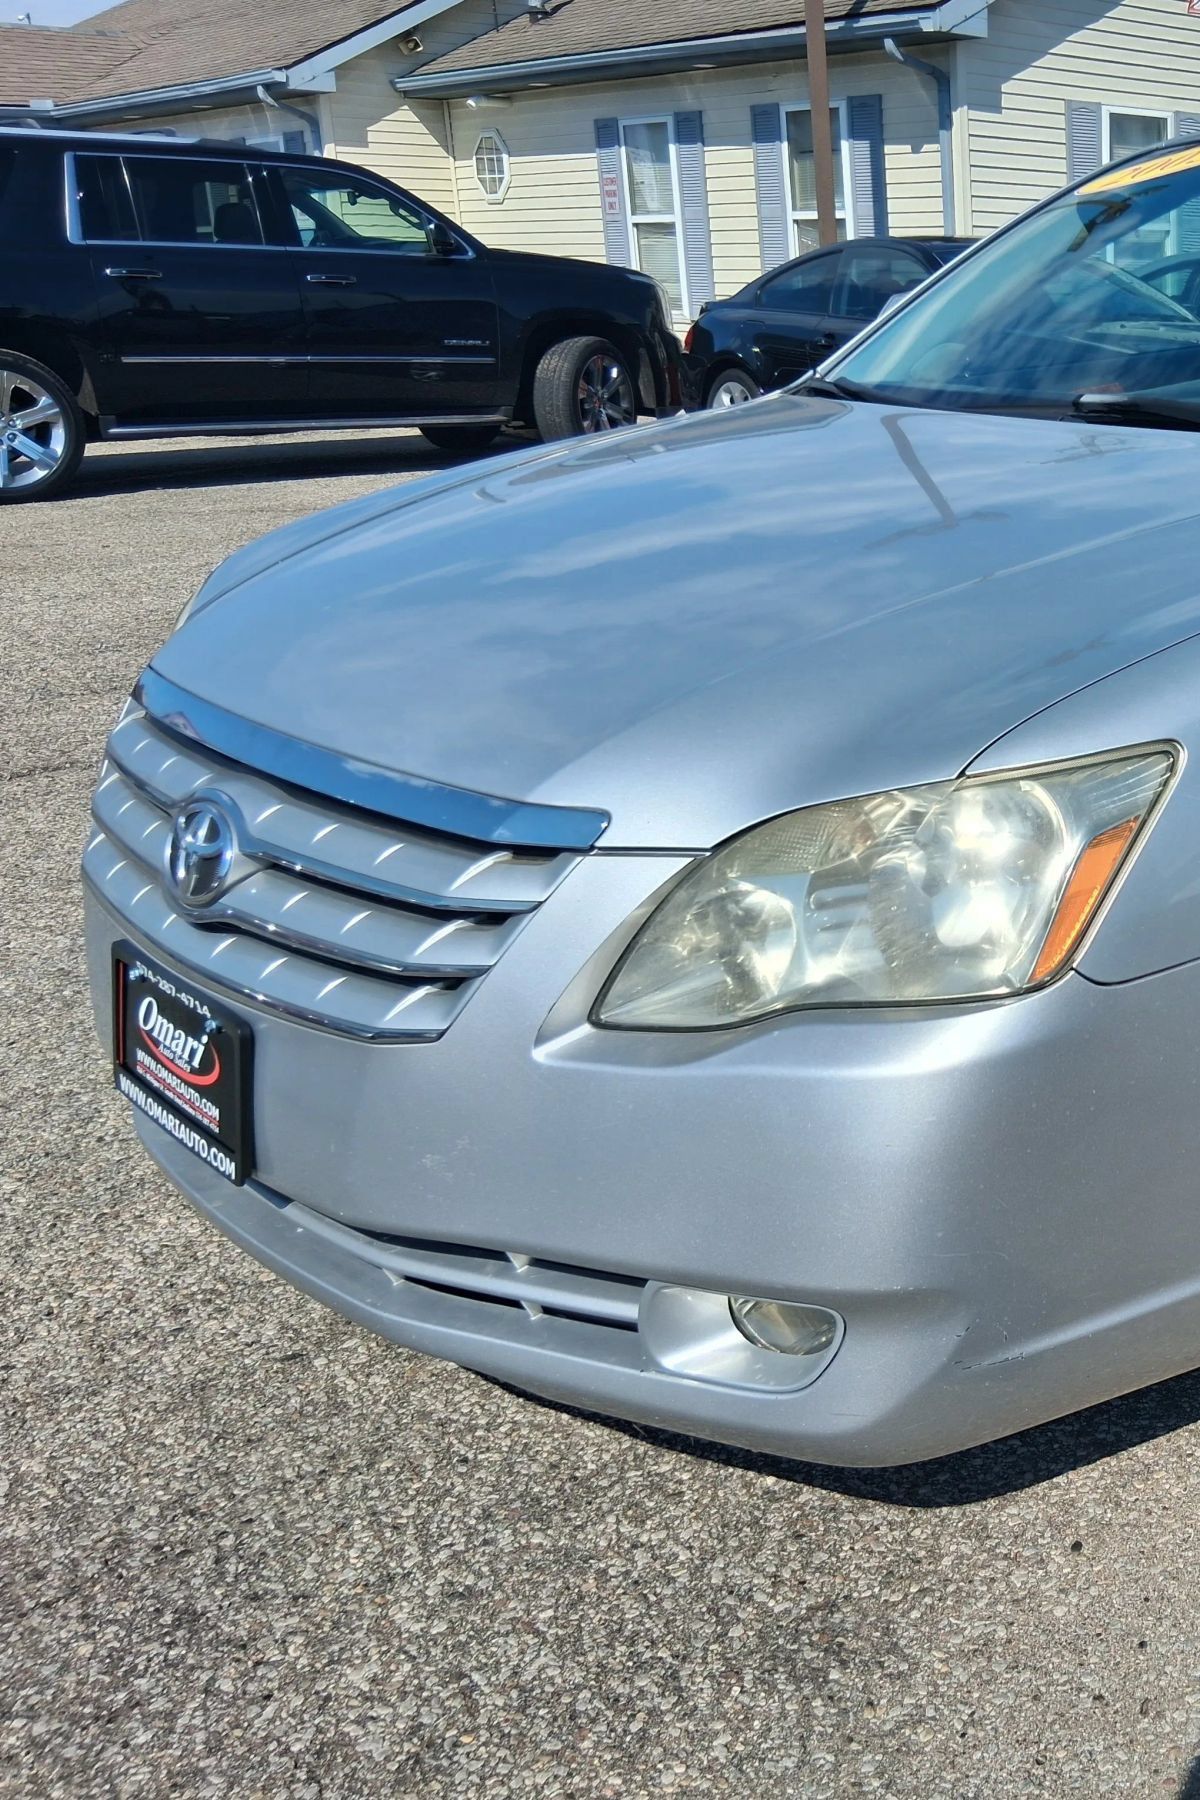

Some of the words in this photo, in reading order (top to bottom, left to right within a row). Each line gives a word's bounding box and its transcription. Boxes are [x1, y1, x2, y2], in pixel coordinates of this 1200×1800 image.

[138, 996, 209, 1069] Omari
[158, 1043, 174, 1060] Auto
[174, 1053, 191, 1073] Sales
[136, 1047, 220, 1121] WWW.OMARIAUTO.COM
[119, 1073, 236, 1180] WWW.OMARIAUTO.COM
